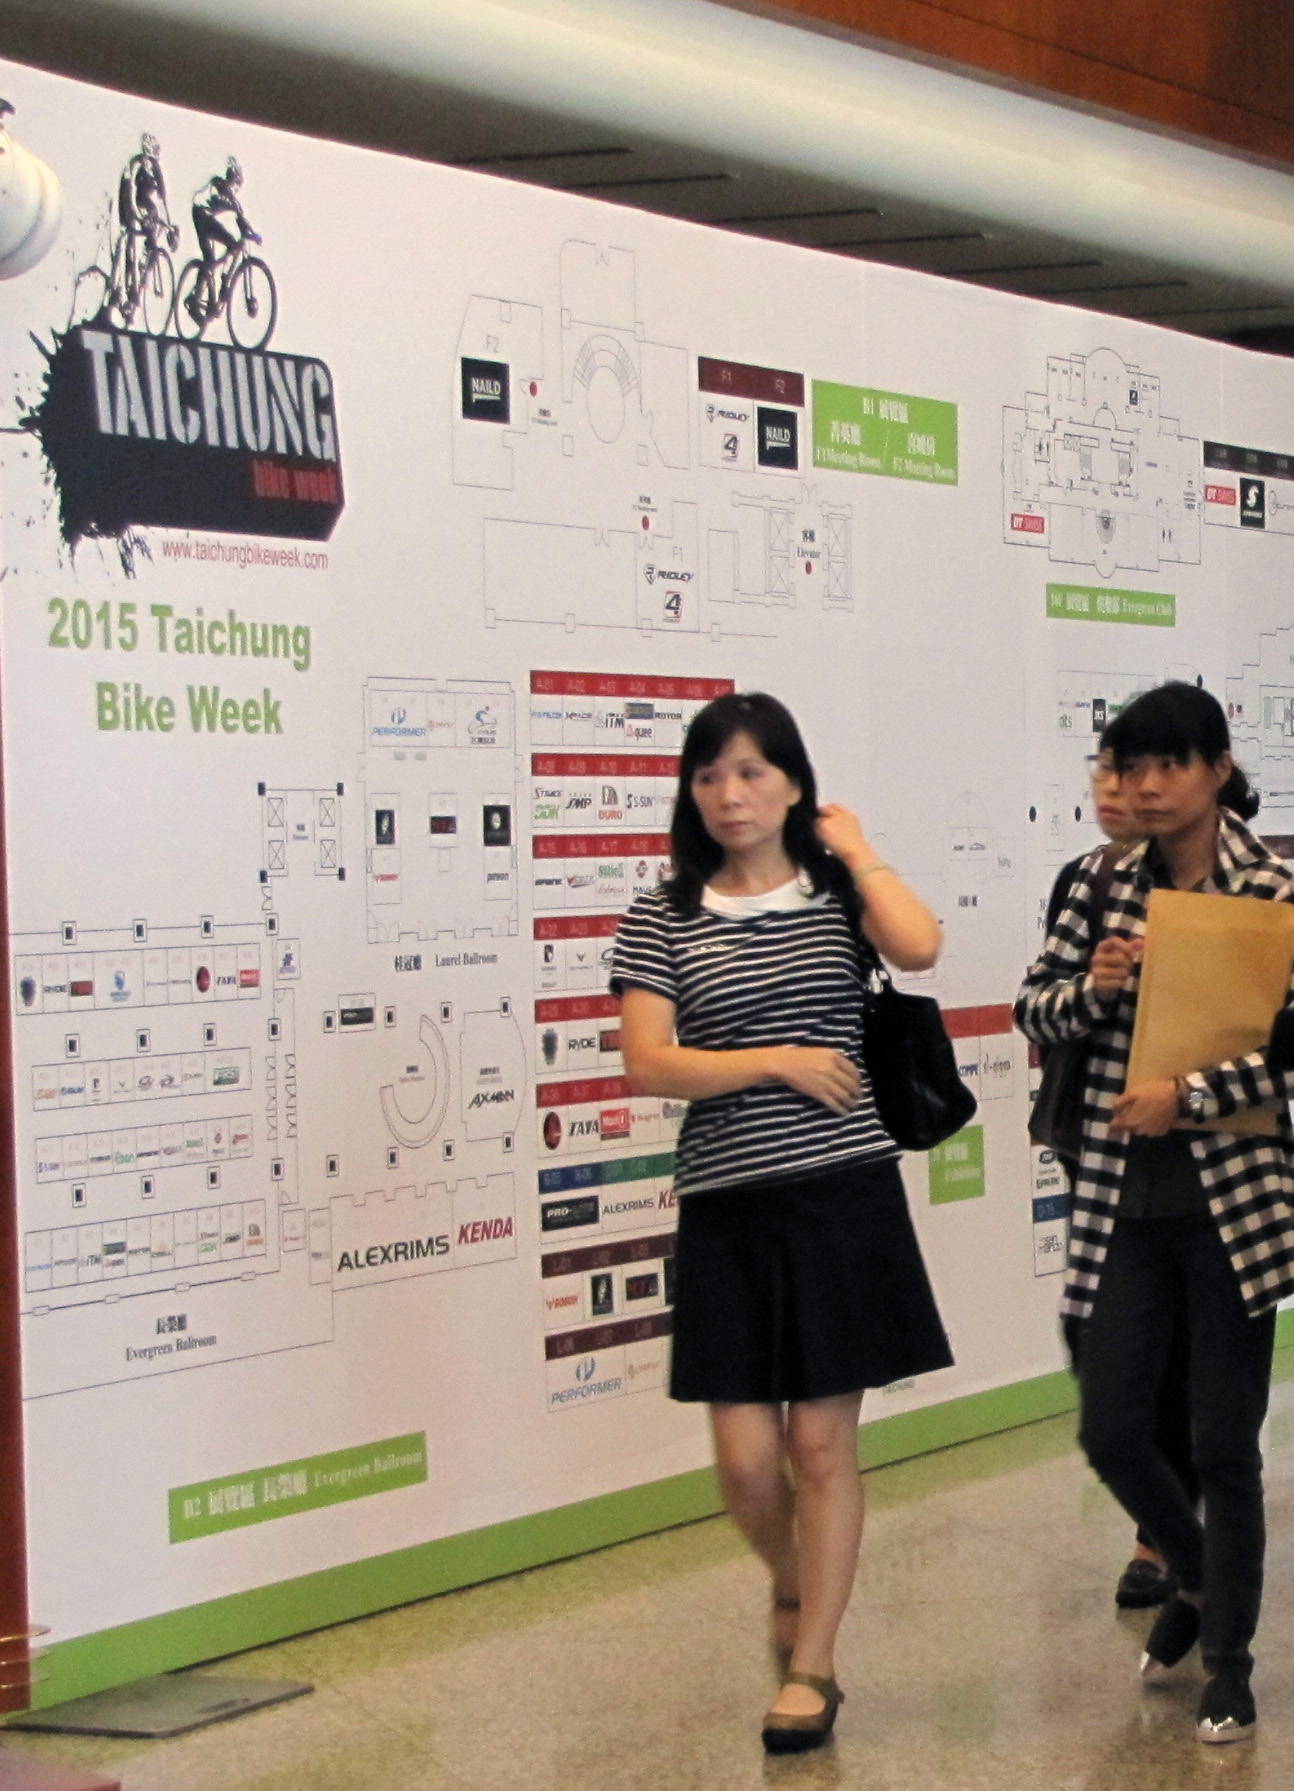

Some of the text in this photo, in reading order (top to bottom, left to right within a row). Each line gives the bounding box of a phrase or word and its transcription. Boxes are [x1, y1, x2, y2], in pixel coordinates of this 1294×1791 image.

[81, 329, 337, 462] TAICHUNG
[162, 540, 329, 569] www.taichungbikeweek.com
[48, 597, 313, 672] 2015 Taichung
[95, 681, 284, 734] Bike Week
[372, 727, 427, 737] PERFORMER
[435, 952, 498, 967] Laurel Ballroom
[603, 1197, 654, 1215] ALEXRIMS
[458, 1216, 513, 1245] KENDA
[337, 1235, 449, 1272] ALEXRIMS
[176, 1335, 217, 1352] Ballroom
[552, 1378, 621, 1403] PERFORMER
